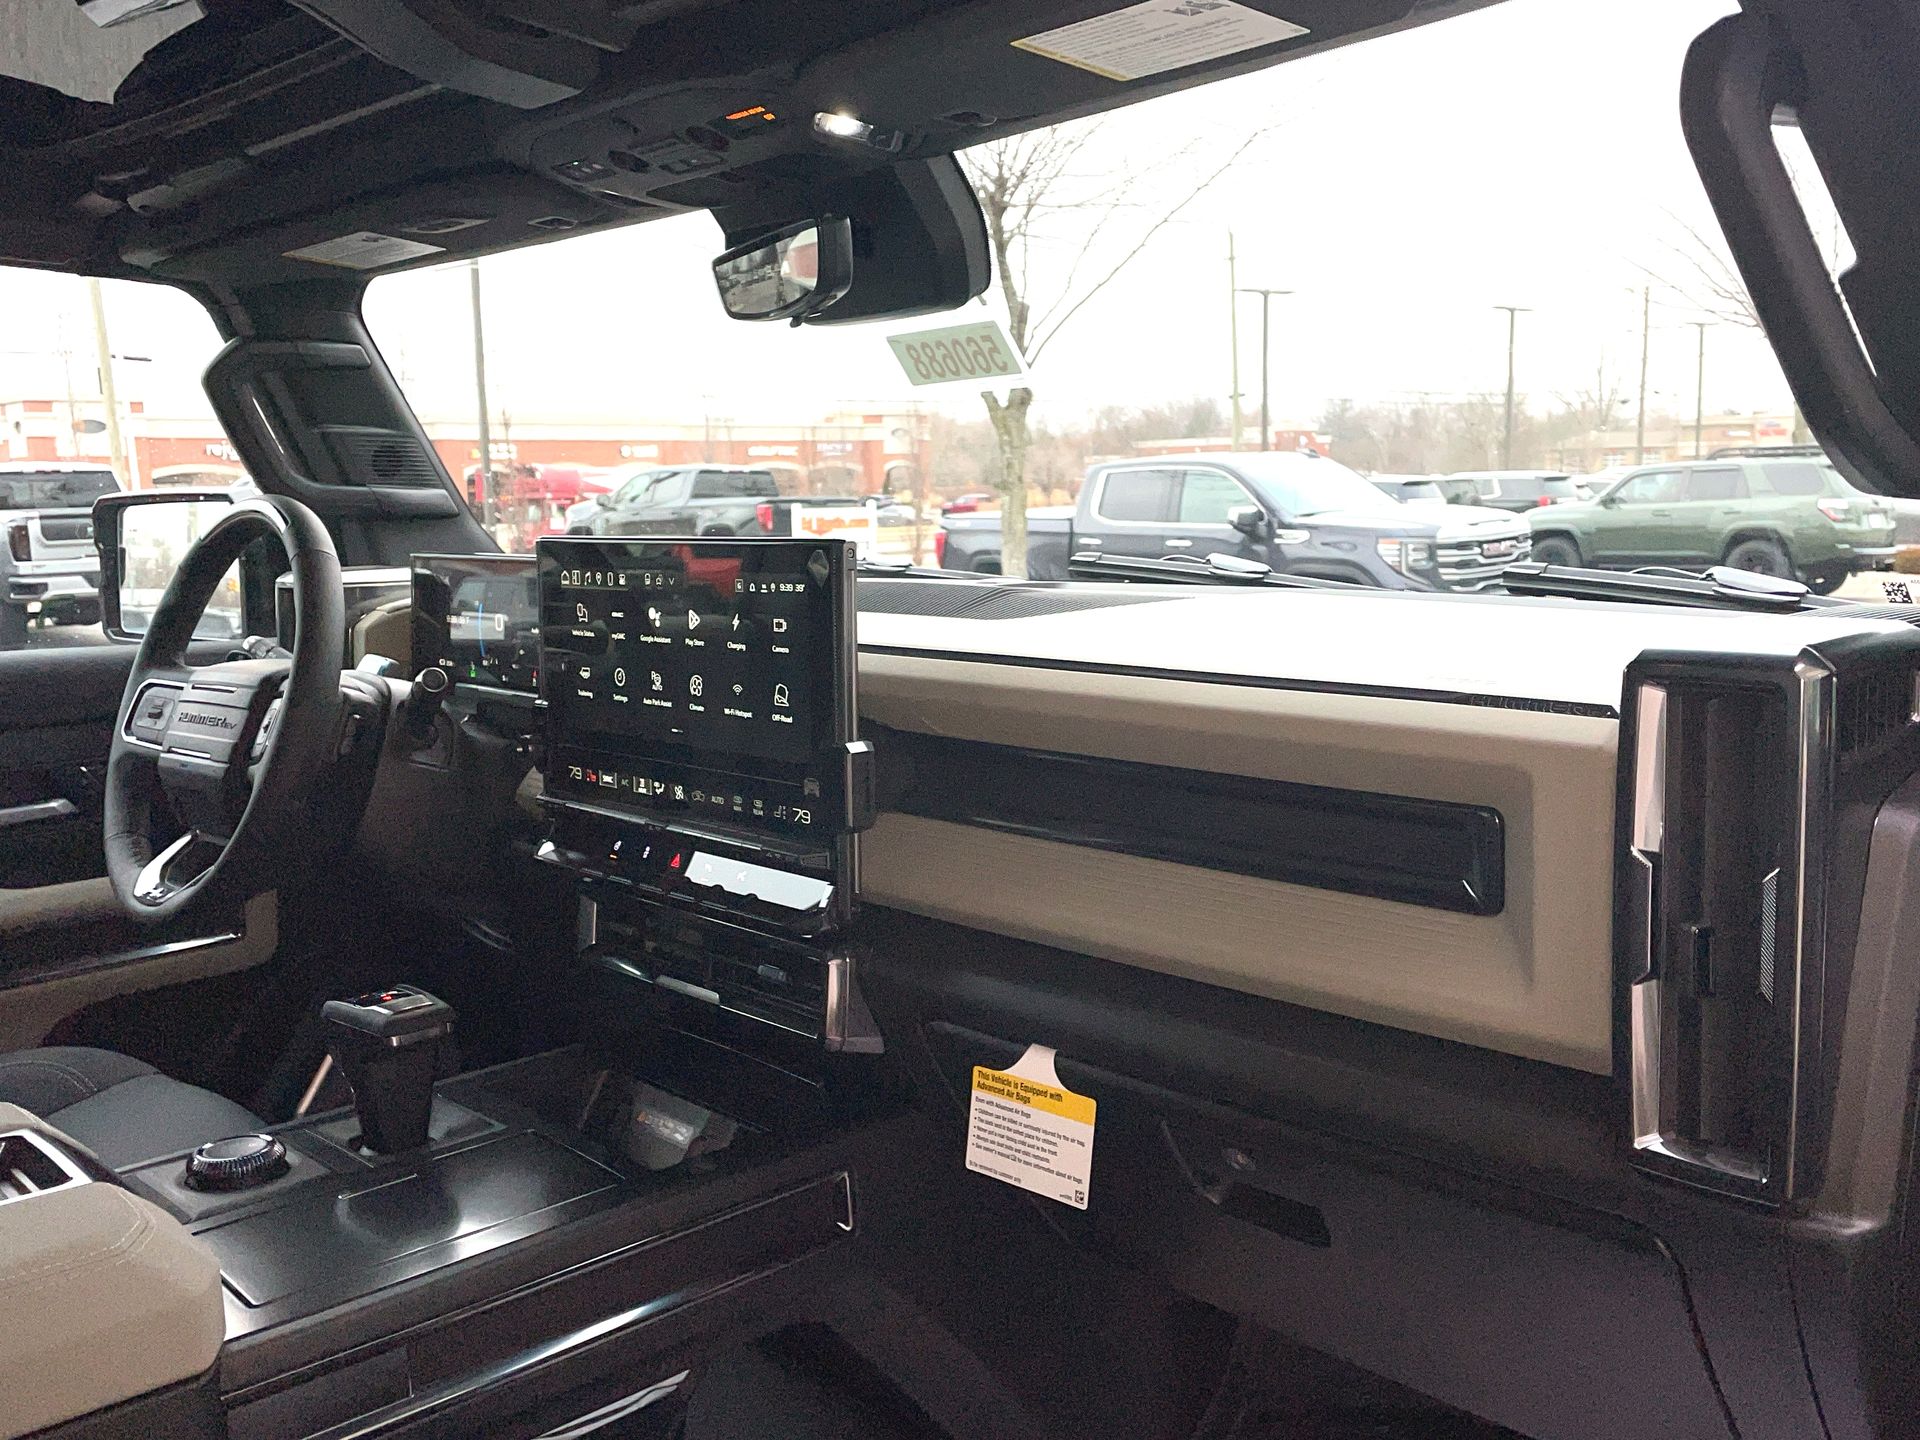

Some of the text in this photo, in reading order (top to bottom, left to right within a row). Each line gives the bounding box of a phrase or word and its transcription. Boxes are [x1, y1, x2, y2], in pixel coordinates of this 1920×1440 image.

[780, 583, 793, 592] 9:39
[640, 634, 653, 643] Google
[685, 638, 705, 647] Play Store
[727, 641, 746, 651] Charging
[772, 645, 789, 653] Camera
[772, 714, 793, 723] Off-Road
[568, 765, 582, 780] 79
[792, 807, 811, 824] 79
[976, 1080, 1004, 1094] Advanced
[1006, 1089, 1014, 1097] Air
[1019, 1082, 1047, 1098] Equipped
[1049, 1091, 1062, 1101] with
